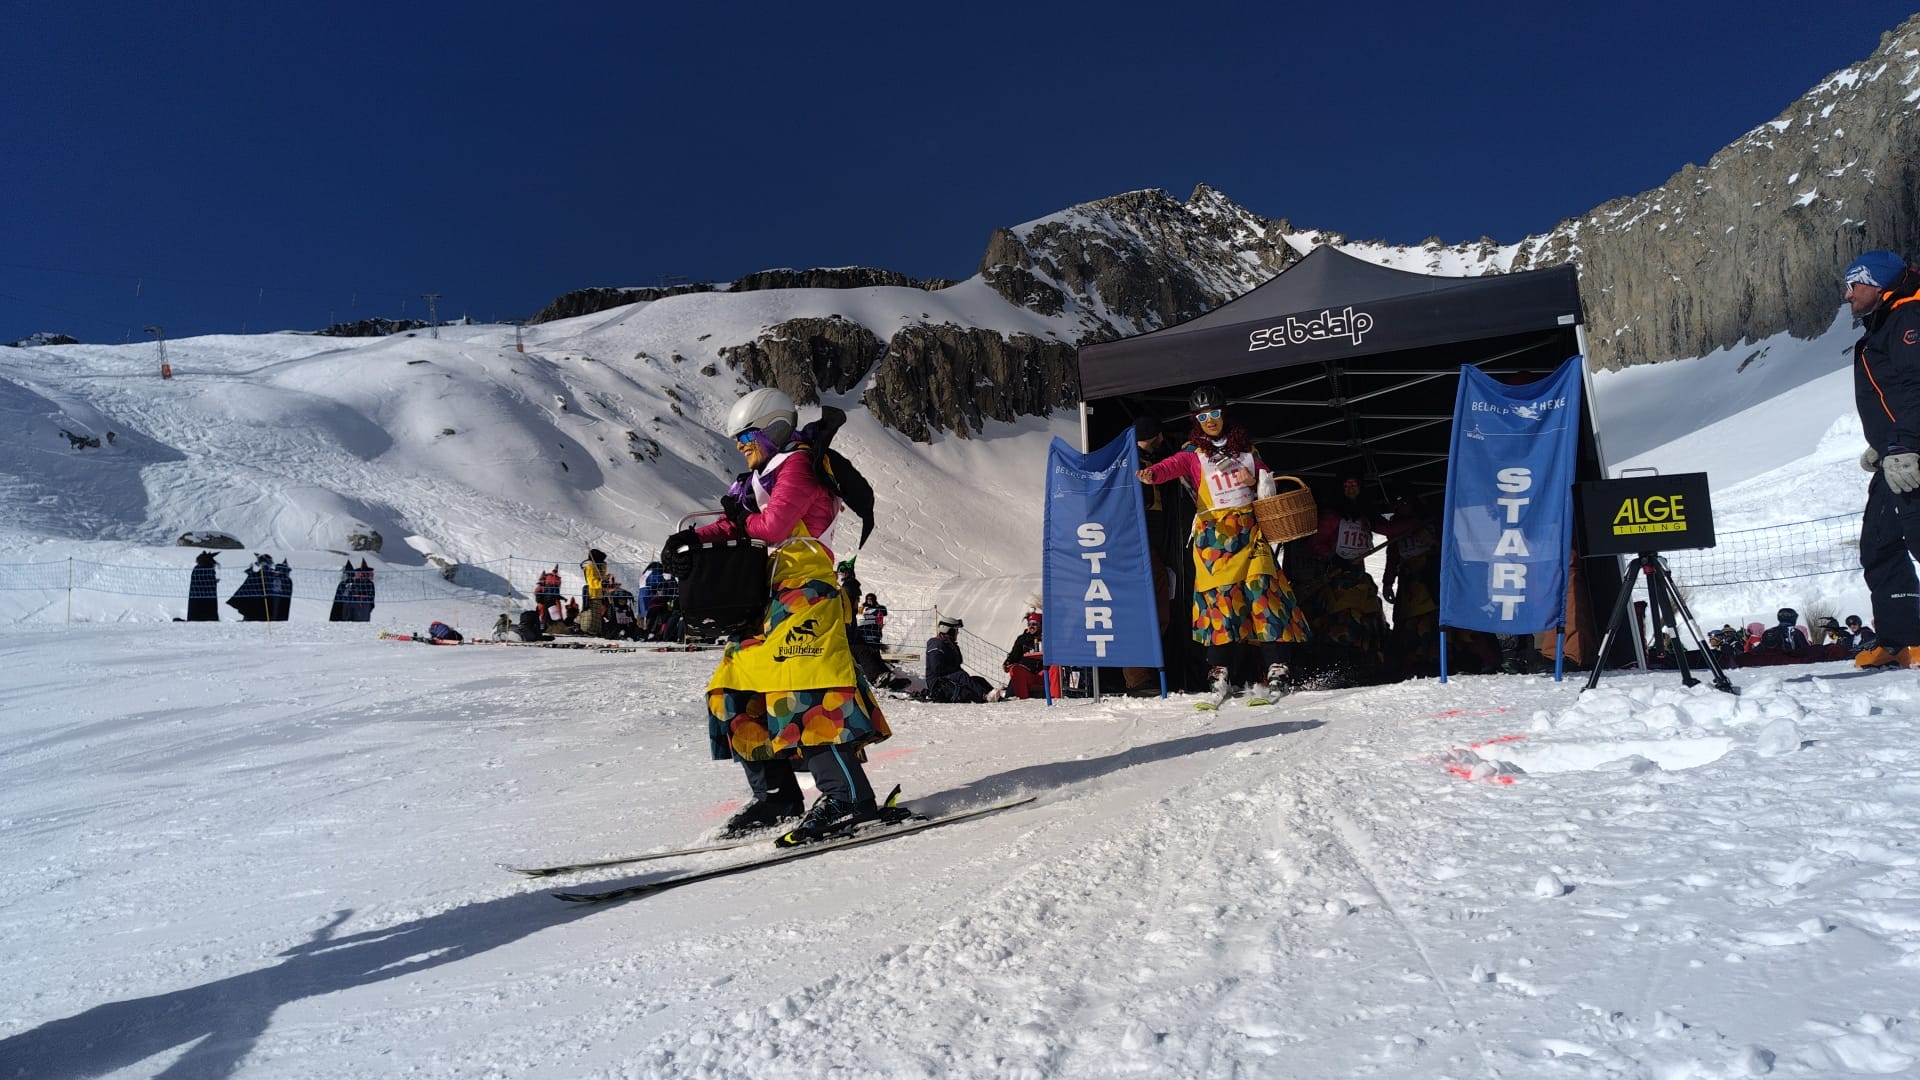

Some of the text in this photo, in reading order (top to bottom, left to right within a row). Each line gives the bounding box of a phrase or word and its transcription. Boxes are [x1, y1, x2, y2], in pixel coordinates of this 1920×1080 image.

[1249, 306, 1373, 351] sc belalp
[1472, 397, 1566, 415] BELALP HEXE
[1211, 468, 1243, 491] 115
[1613, 495, 1685, 524] ALGE
[1620, 522, 1681, 533] TIMING
[1492, 467, 1532, 620] START
[1077, 522, 1114, 657] START
